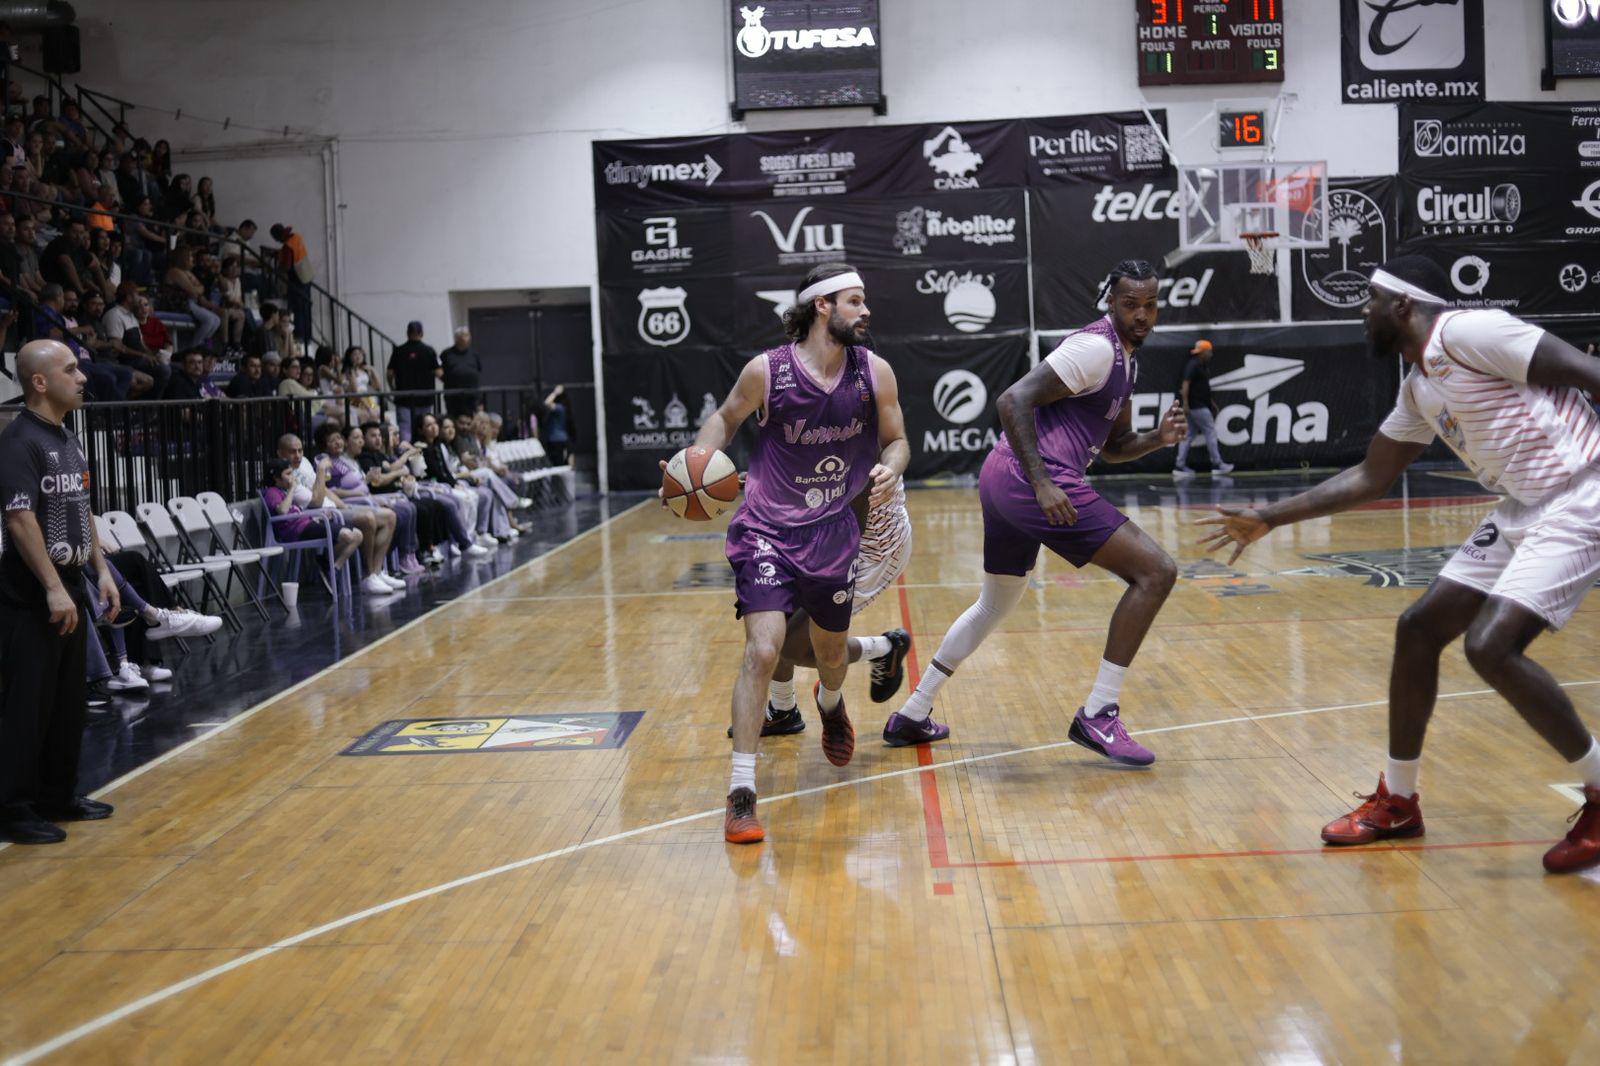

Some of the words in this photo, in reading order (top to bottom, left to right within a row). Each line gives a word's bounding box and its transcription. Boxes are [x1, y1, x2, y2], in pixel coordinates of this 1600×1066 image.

[1193, 4, 1227, 13] PERIOD
[1140, 25, 1187, 38] HOME
[1230, 23, 1282, 36] VISITOR
[769, 27, 876, 50] TUFESA
[1141, 41, 1175, 51] FOULS
[1191, 39, 1230, 50] PLAYER
[1247, 38, 1281, 48] FOULS
[1166, 52, 1172, 73] 1
[1265, 49, 1278, 70] 3
[1347, 79, 1479, 98] caliente.mx
[1235, 114, 1261, 143] 16
[1029, 129, 1118, 156] Perfiles
[799, 153, 830, 169] PESO
[830, 152, 856, 167] BAR
[604, 161, 706, 189] tinymex
[1422, 225, 1514, 236] LLANTERO
[1484, 298, 1520, 308] Company
[648, 311, 682, 336] 66
[1131, 391, 1330, 448] Flcha
[923, 427, 998, 453] MEGA
[795, 475, 828, 484] Banco
[754, 576, 782, 586] MEGA
